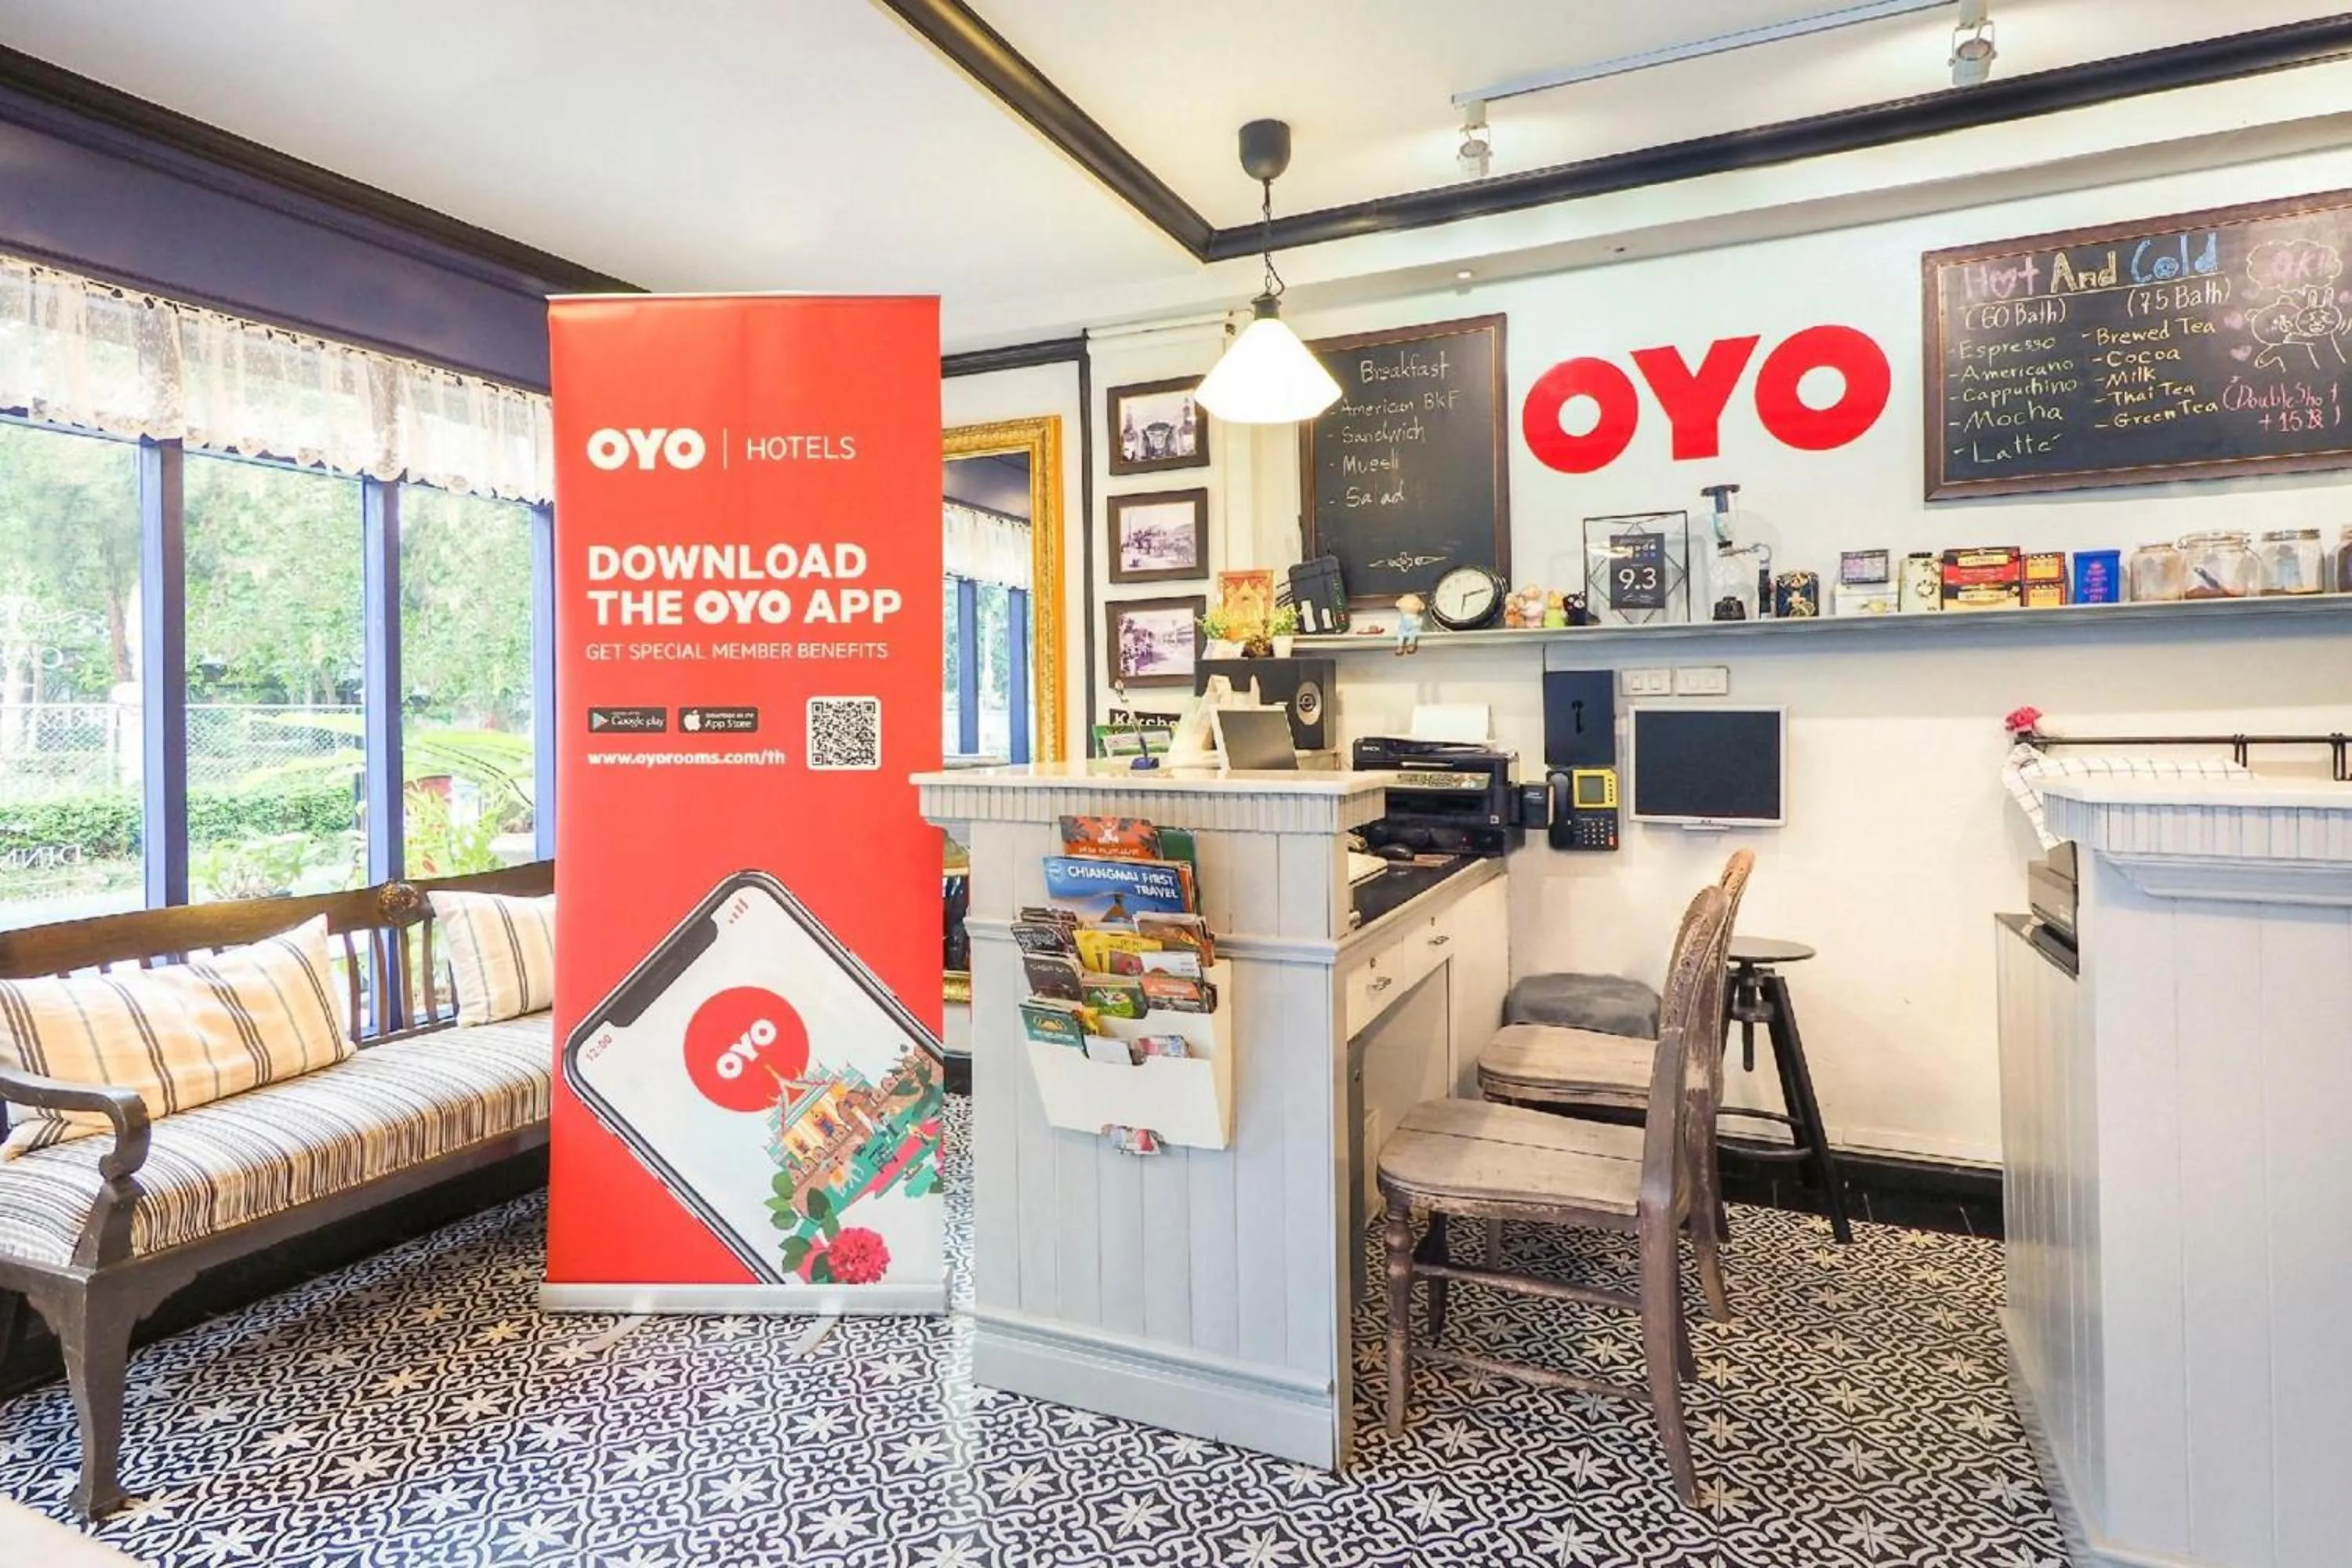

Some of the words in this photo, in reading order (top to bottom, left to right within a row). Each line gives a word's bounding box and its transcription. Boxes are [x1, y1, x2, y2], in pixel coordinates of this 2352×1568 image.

[2050, 249, 2117, 293] And
[2131, 232, 2218, 283] Cold
[2015, 296, 2067, 326] Bath)
[2127, 289, 2169, 319] (75
[2175, 277, 2231, 310] Bath)
[2096, 320, 2170, 346] Brewed
[2175, 316, 2216, 335] Tea
[1959, 336, 2056, 367] Espresso
[2106, 348, 2182, 367] Cocoa
[1359, 350, 1450, 383] Breakfast
[1960, 359, 2074, 383] Americano
[2105, 366, 2157, 390] Milk
[1341, 397, 1414, 417] American
[1522, 324, 1892, 474] OYO
[2107, 386, 2154, 407] Thai
[2158, 382, 2196, 397] Tea
[1963, 400, 2063, 433] Mocha
[2114, 408, 2176, 428] Green
[2178, 399, 2219, 414] Tea
[1341, 415, 1426, 445] Sandwich
[586, 427, 706, 470] OYO
[746, 436, 857, 461] HOTELS
[1345, 478, 1405, 507] Salad
[587, 543, 867, 581] DOWNLOAD
[1618, 567, 1657, 590] 9.3
[586, 590, 684, 626] THE
[693, 589, 792, 625] OYO
[802, 588, 902, 624] APP
[585, 643, 623, 660] GET
[628, 642, 706, 660] SPECIAL
[712, 642, 793, 659] MEMBER
[797, 641, 888, 659] BENEFITS
[612, 715, 644, 728] Google
[705, 719, 725, 729] App
[726, 719, 752, 729] Store
[586, 749, 786, 768] www.oyorooms.com/th
[1134, 884, 1179, 899] TRAVEL
[716, 1018, 777, 1079] OYO
